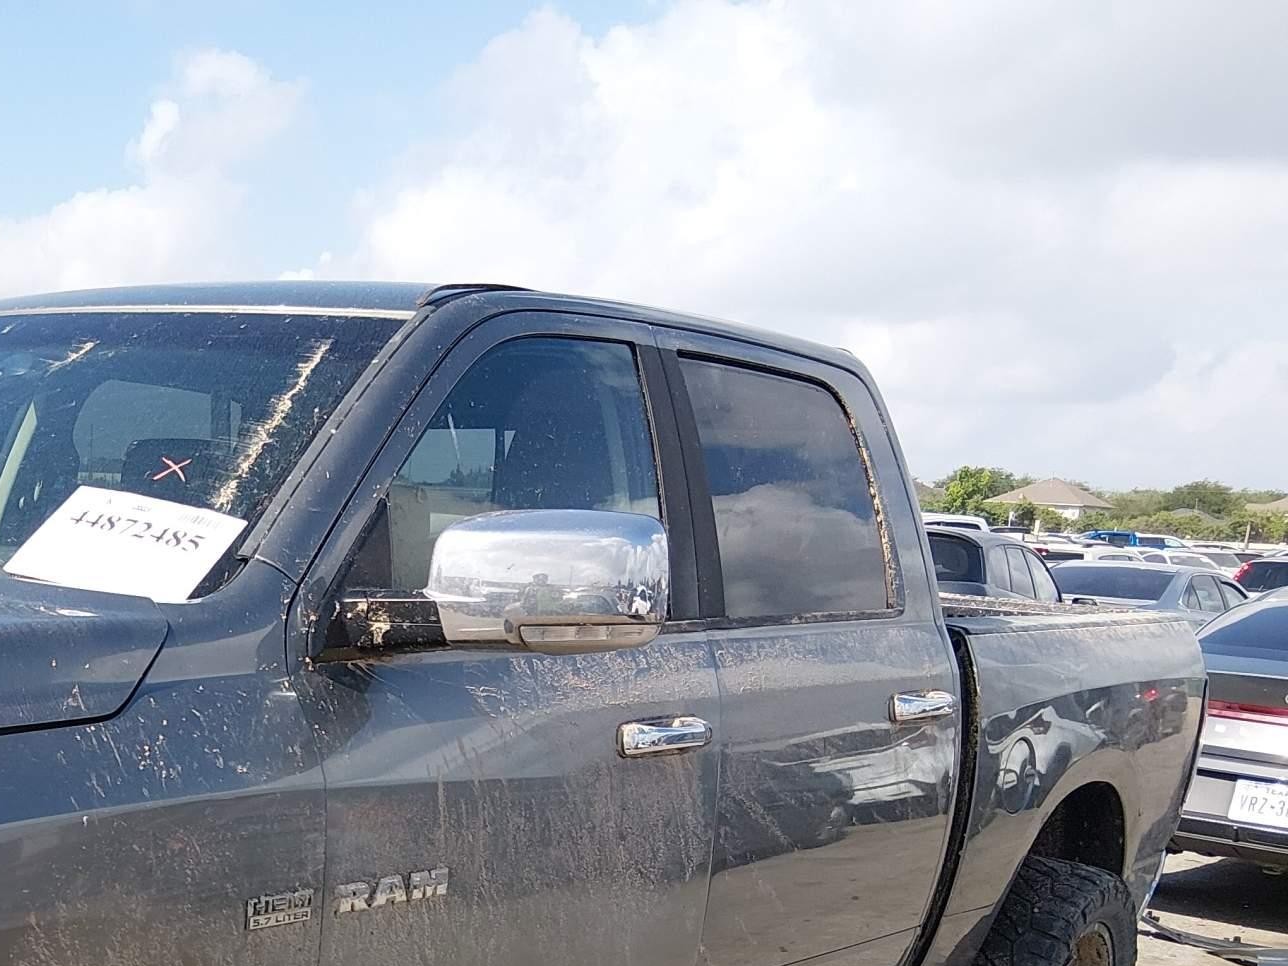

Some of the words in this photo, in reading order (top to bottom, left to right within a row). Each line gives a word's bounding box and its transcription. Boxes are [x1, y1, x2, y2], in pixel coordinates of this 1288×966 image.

[70, 510, 206, 552] 44872485
[334, 867, 449, 914] RAM
[252, 916, 272, 928] 5.7
[275, 910, 309, 923] LITER
